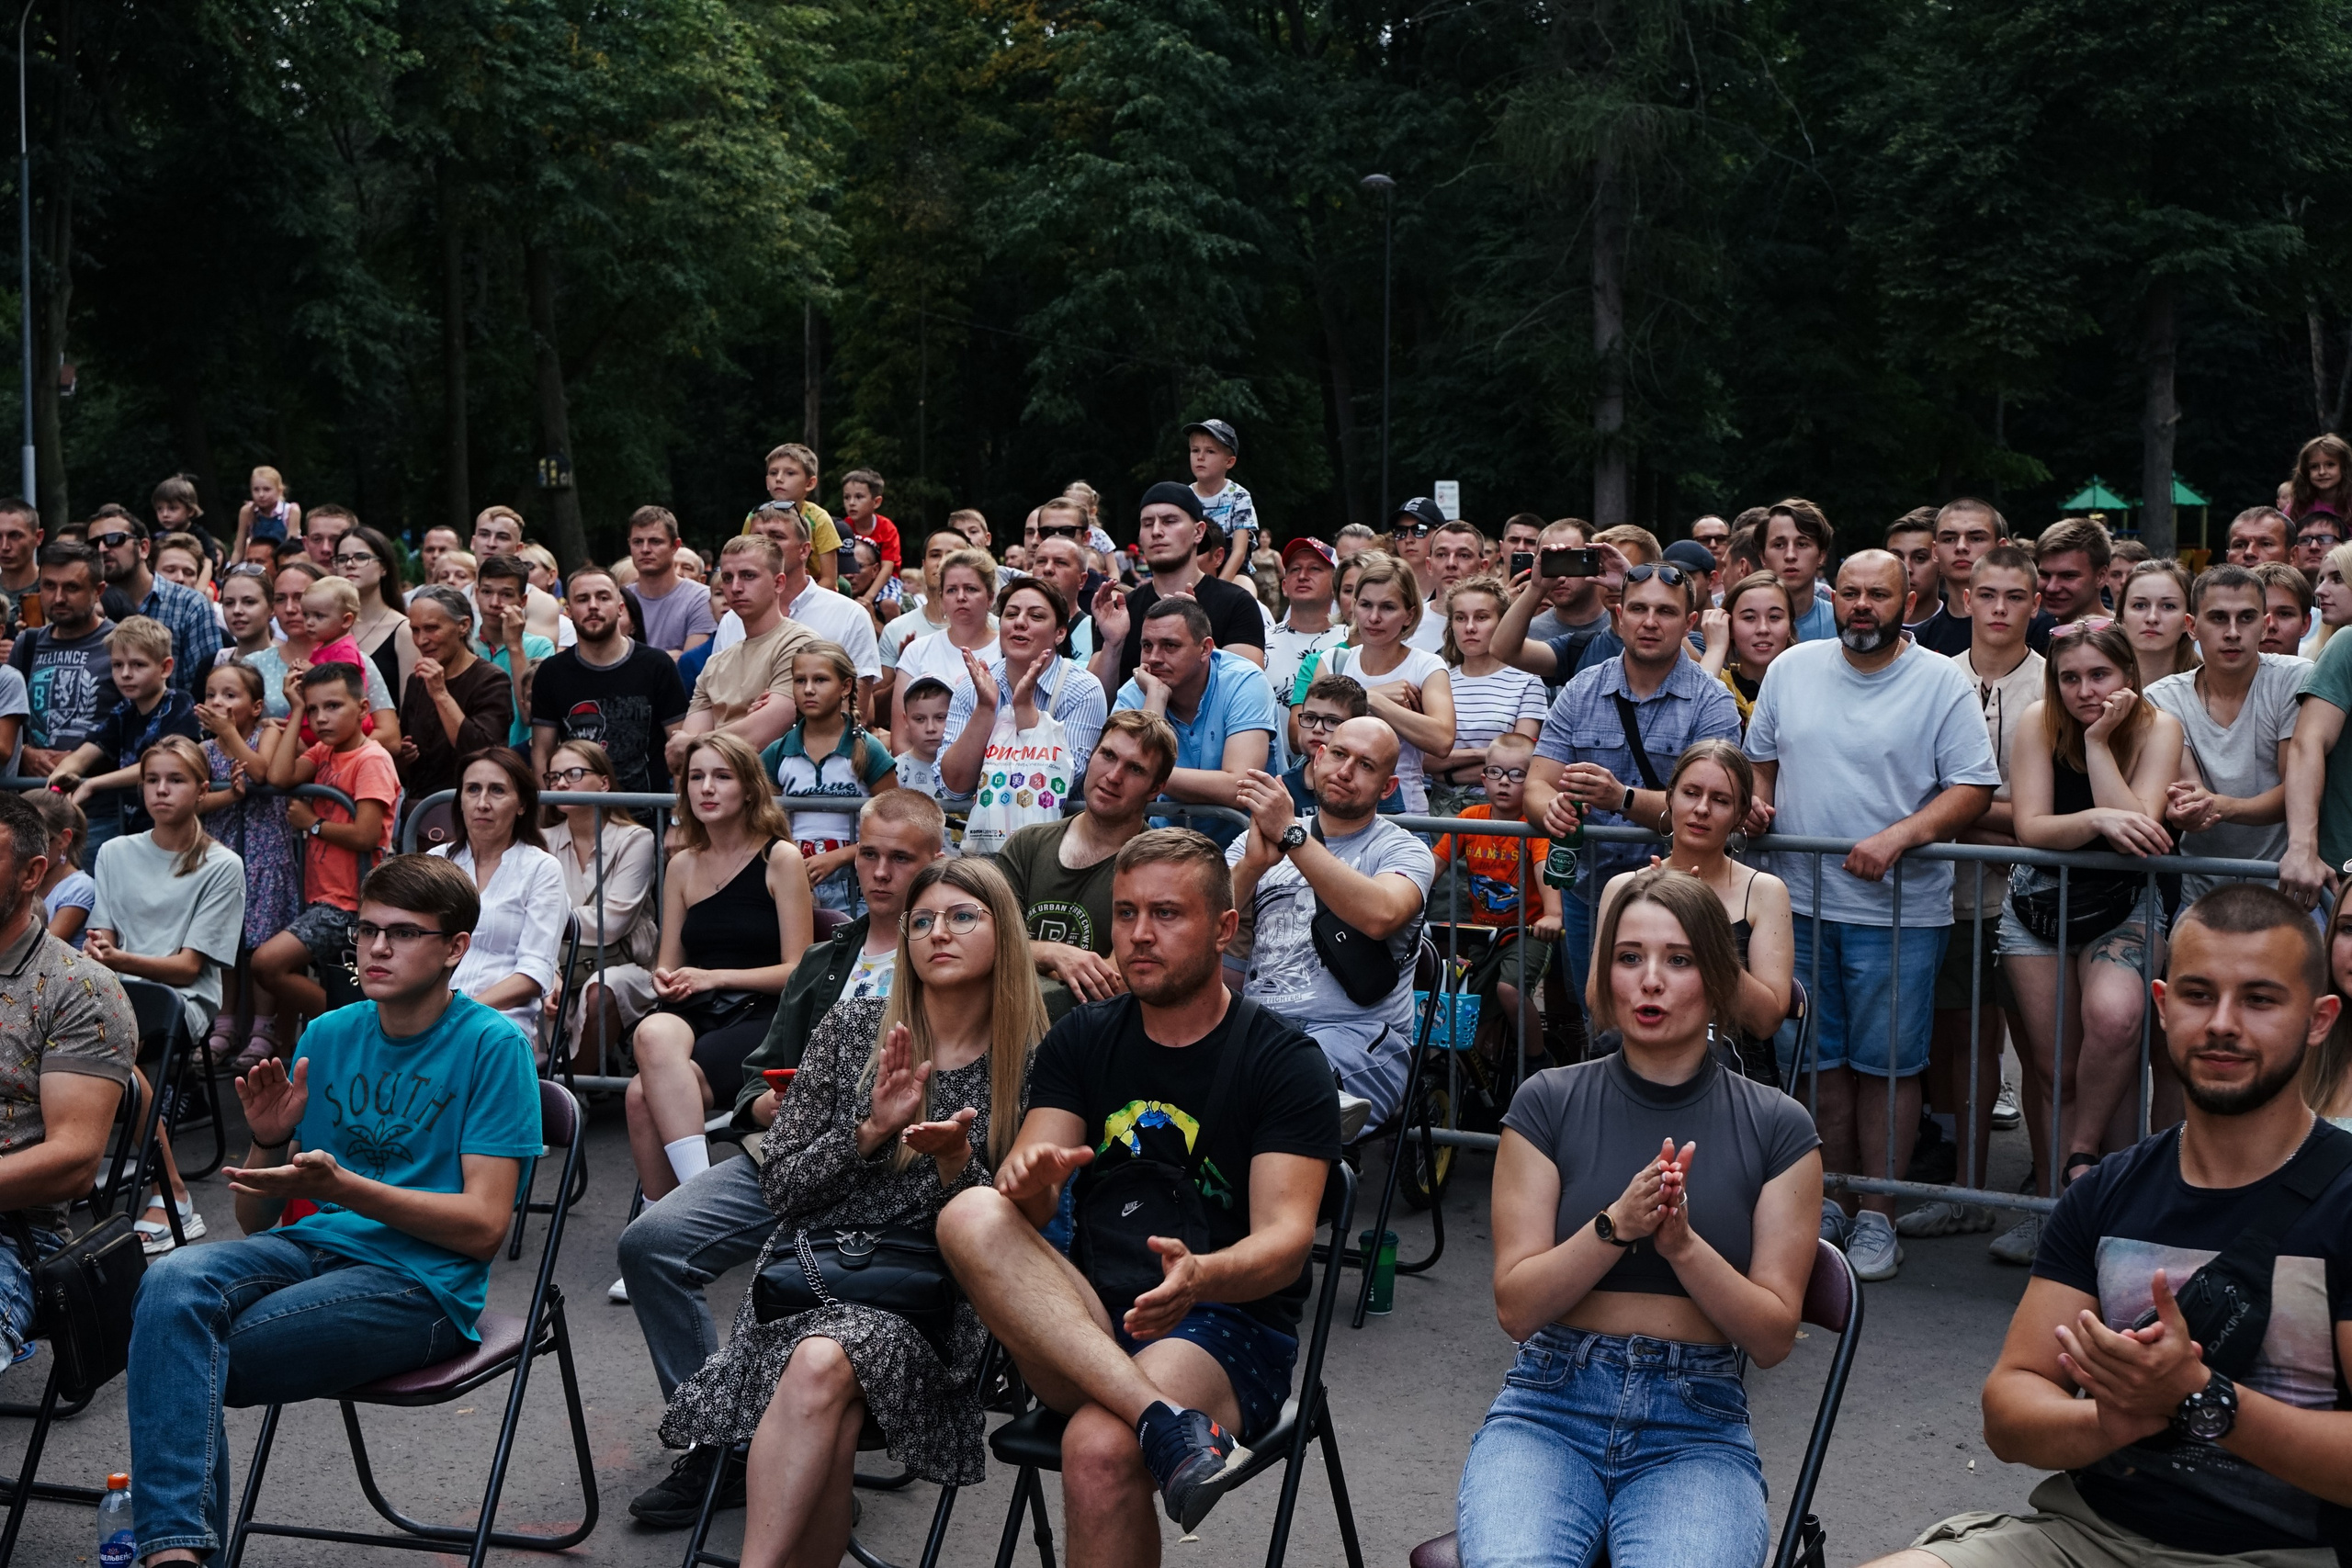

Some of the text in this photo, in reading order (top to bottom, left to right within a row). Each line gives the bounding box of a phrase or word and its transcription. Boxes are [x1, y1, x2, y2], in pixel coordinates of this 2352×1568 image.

[36, 649, 90, 665] ALLIANCE
[34, 685, 46, 711] B
[985, 745, 1063, 761] ФИСМАГ
[1465, 846, 1520, 861] GAMES
[1037, 904, 1068, 912] URBAN
[1080, 919, 1091, 950] CREWS
[324, 1071, 457, 1132] SOUTH
[1124, 1201, 1138, 1213] NIKE
[2208, 1302, 2250, 1354] DAKINE
